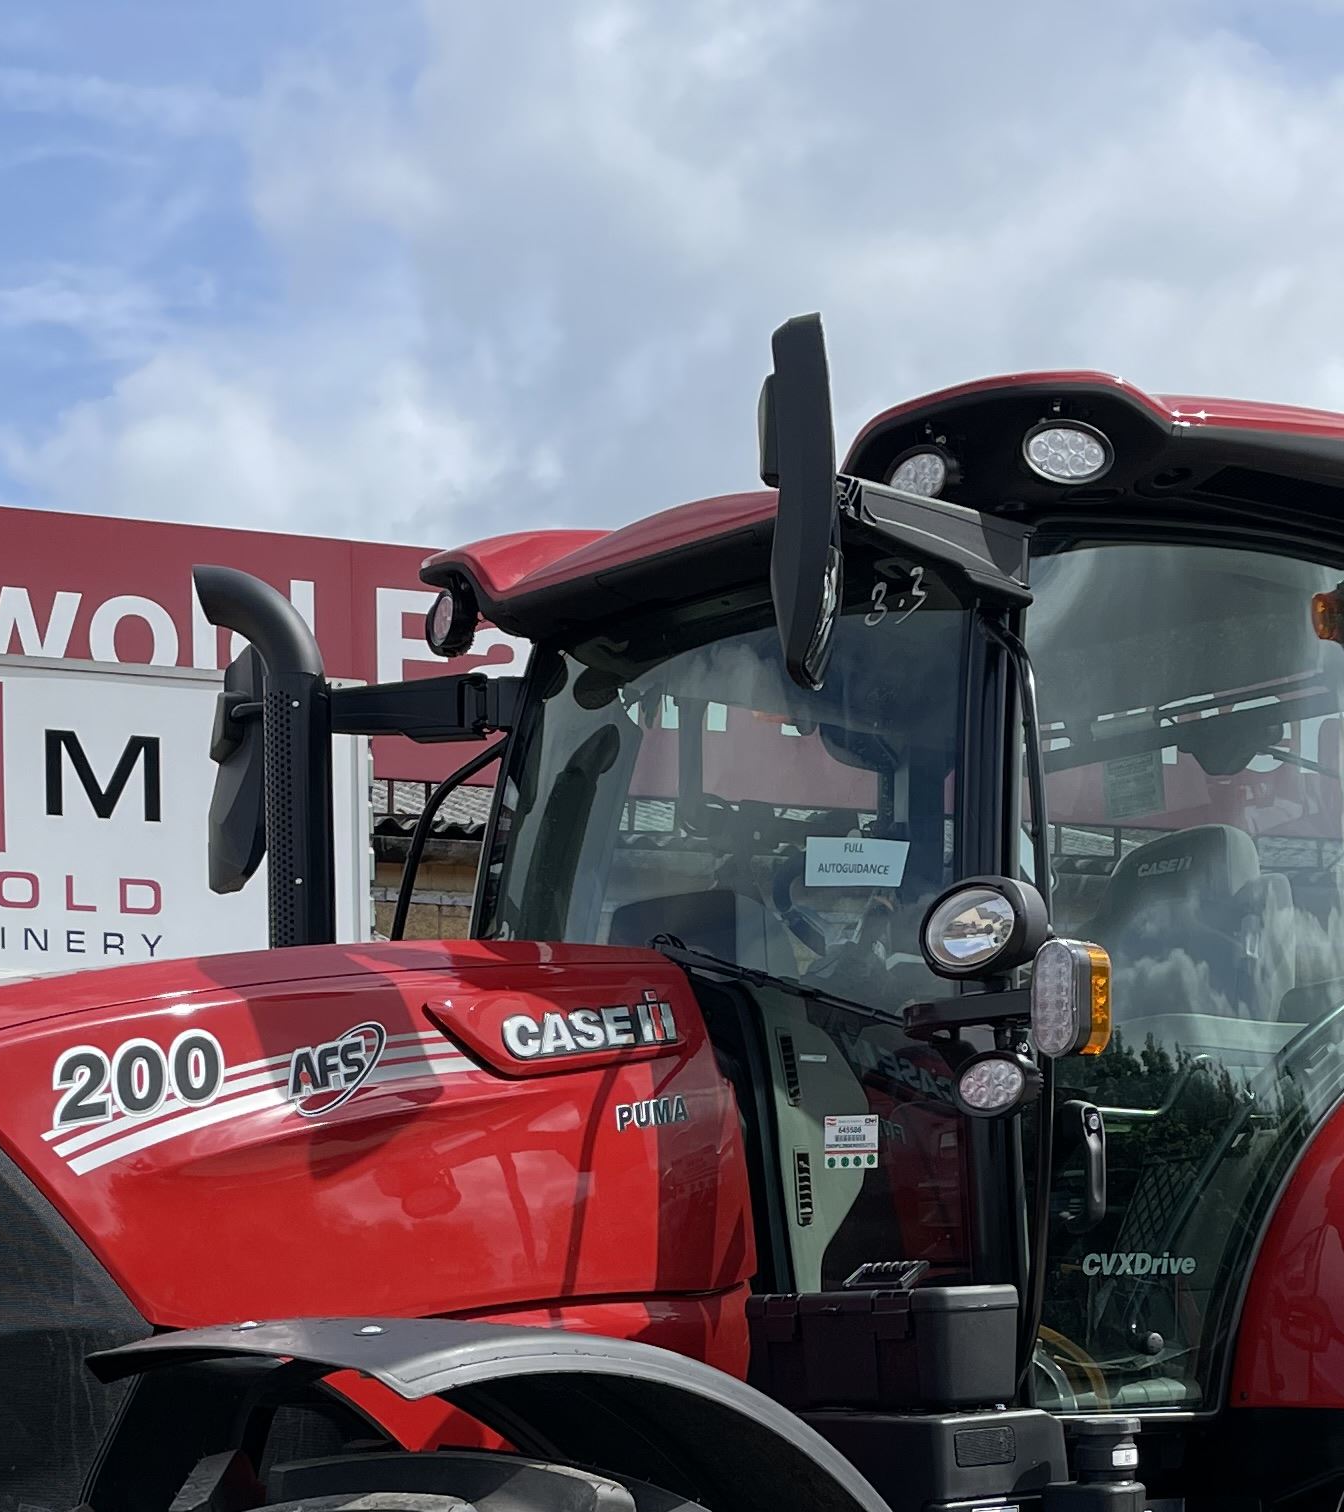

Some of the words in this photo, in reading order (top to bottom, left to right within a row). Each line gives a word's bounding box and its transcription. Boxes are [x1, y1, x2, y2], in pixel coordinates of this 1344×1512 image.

[843, 843, 864, 853] FULL
[817, 863, 889, 875] AUTOGUIDANCE
[502, 1007, 635, 1057] CASE
[52, 1027, 225, 1130] 200
[288, 1034, 368, 1099] AFS
[616, 1095, 689, 1132] PUMA
[1082, 1252, 1196, 1276] CVXDrive
